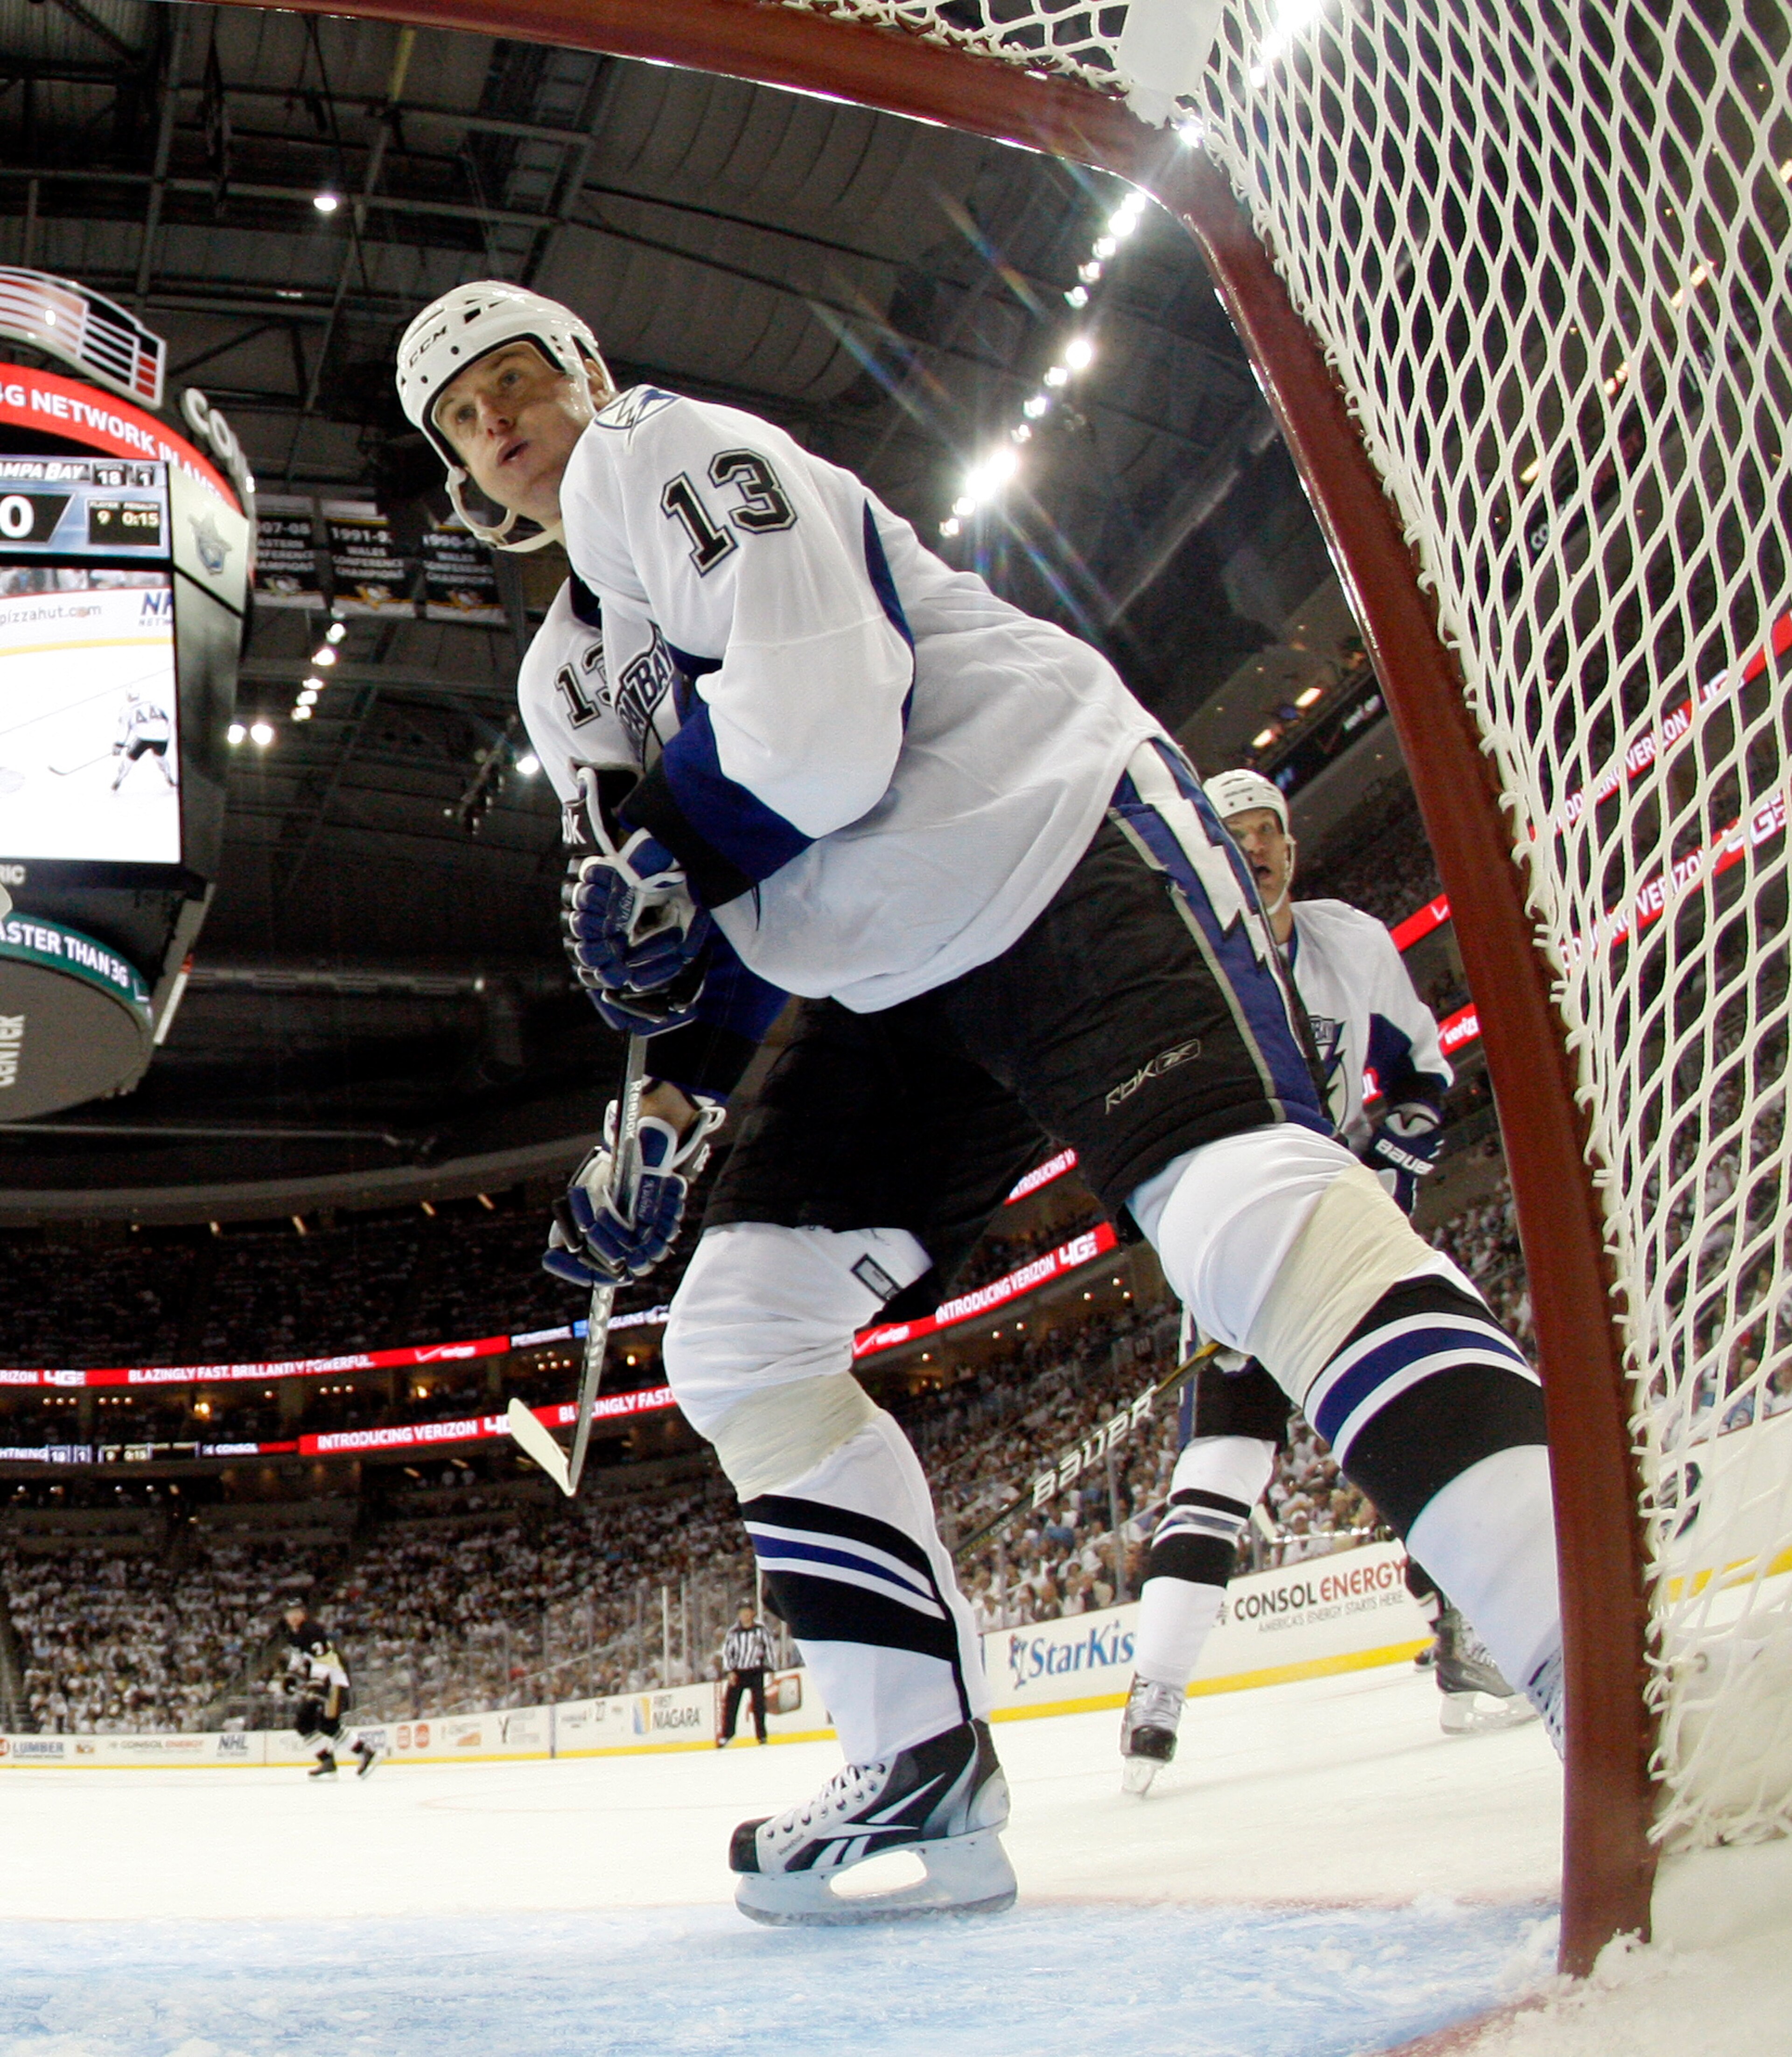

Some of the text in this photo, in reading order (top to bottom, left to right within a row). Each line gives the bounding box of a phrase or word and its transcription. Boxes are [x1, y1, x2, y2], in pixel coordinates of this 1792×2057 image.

[410, 325, 447, 368] CCM
[0, 381, 26, 407] G
[31, 389, 157, 456] NETWORK
[159, 442, 180, 467] IN
[45, 462, 85, 481] BAY
[98, 470, 121, 485] 18
[140, 473, 150, 486] 1
[0, 494, 34, 538] 0
[97, 510, 159, 527] 9 0:15
[660, 448, 798, 577] 13
[1625, 709, 1690, 772] VERION
[64, 936, 111, 976] THAN
[111, 959, 129, 988] 3G
[626, 1080, 643, 1138] Reebok
[936, 1236, 1093, 1324] INTRODUCING VERIZON 4G
[44, 1370, 79, 1386] 4G
[128, 1367, 196, 1383] BLAZINGLY
[559, 1394, 637, 1422] BLINGLY
[318, 1427, 413, 1450] INTRODUCING
[414, 1419, 478, 1440] VERIZON
[1235, 1559, 1407, 1621] CONSOL ENERGY
[218, 1734, 248, 1750] NHL
